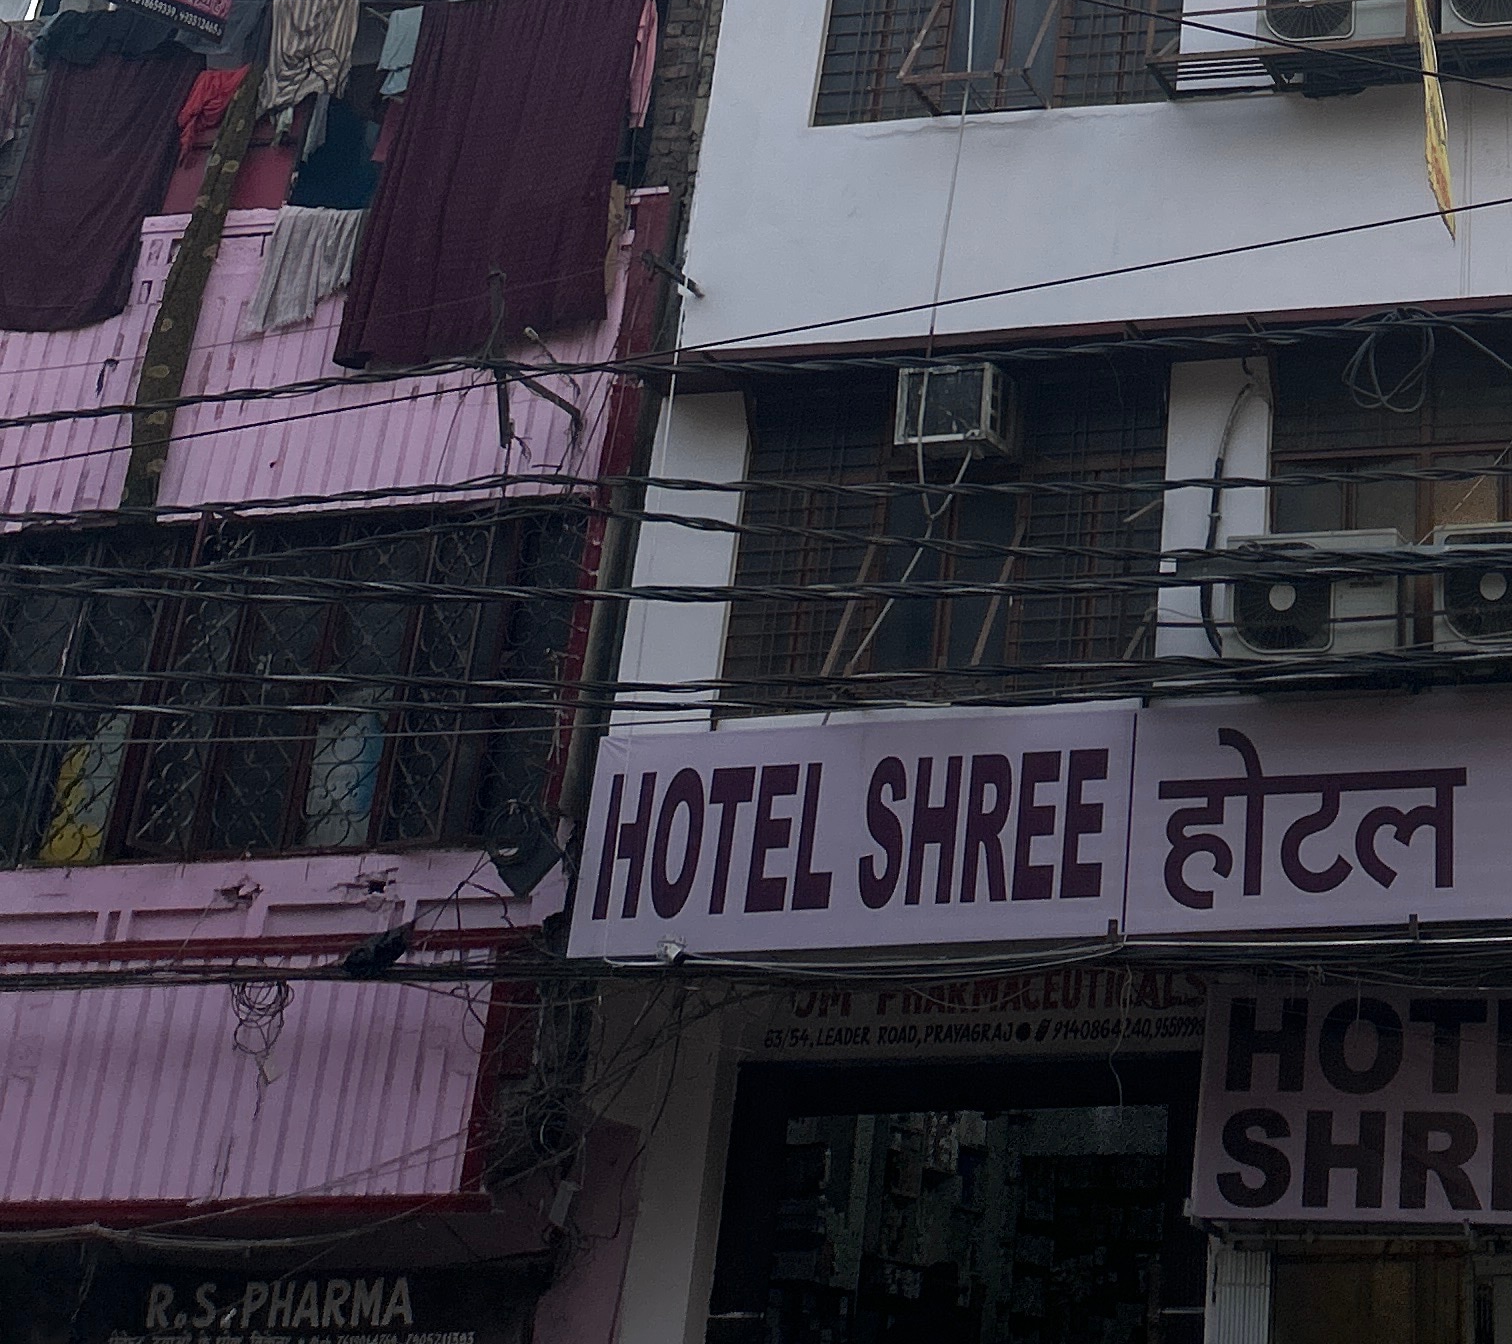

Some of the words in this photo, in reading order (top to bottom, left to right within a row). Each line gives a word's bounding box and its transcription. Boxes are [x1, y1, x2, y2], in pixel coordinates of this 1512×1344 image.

[592, 763, 832, 921] HOTEL
[858, 749, 1109, 909] SHREE
[1158, 727, 1467, 910] होटल
